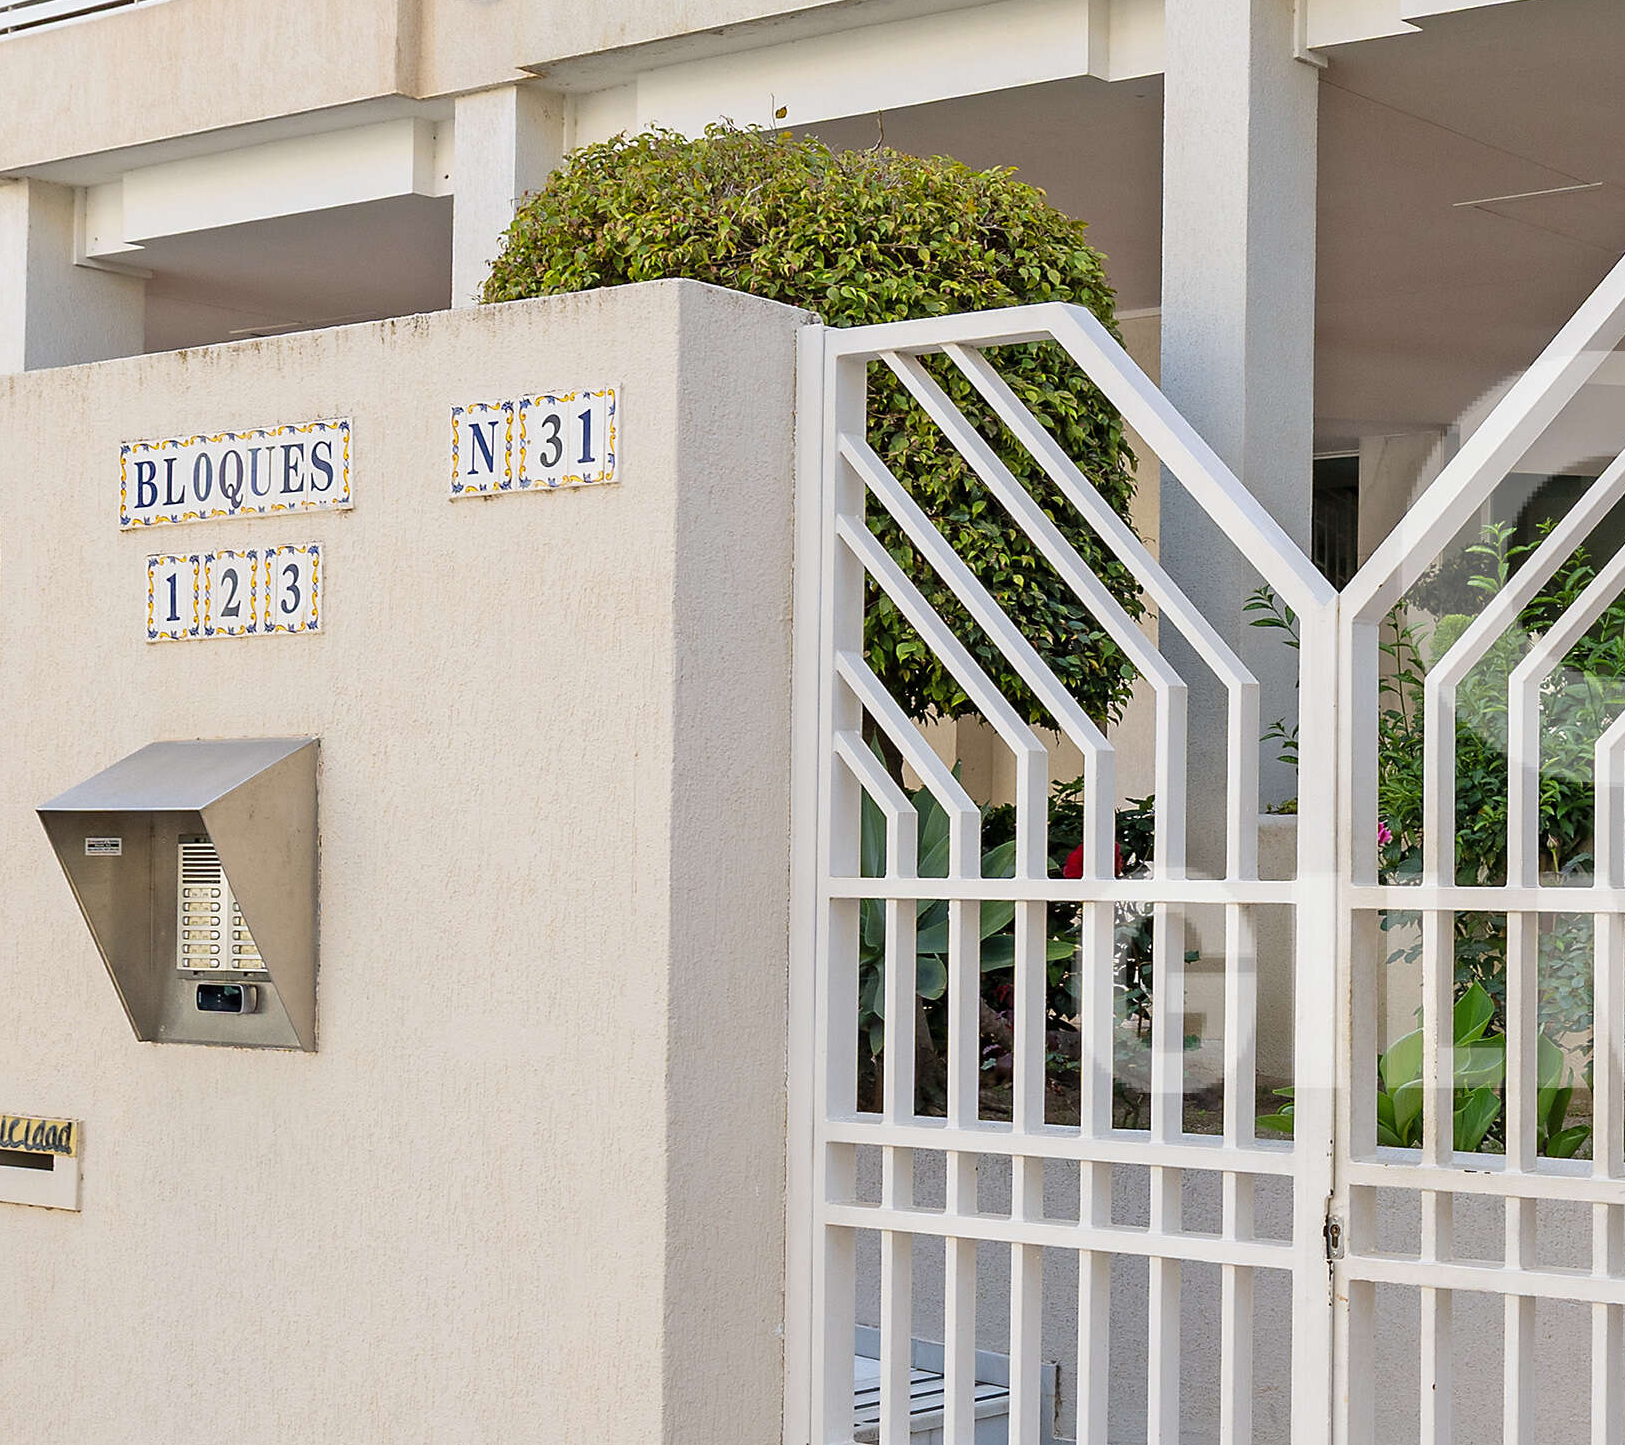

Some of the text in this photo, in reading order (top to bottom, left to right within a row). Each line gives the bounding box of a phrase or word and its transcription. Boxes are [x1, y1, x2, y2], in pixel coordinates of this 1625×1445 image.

[540, 409, 595, 468] 31
[134, 441, 334, 509] BLOQUES
[166, 563, 301, 622] 1 2 3
